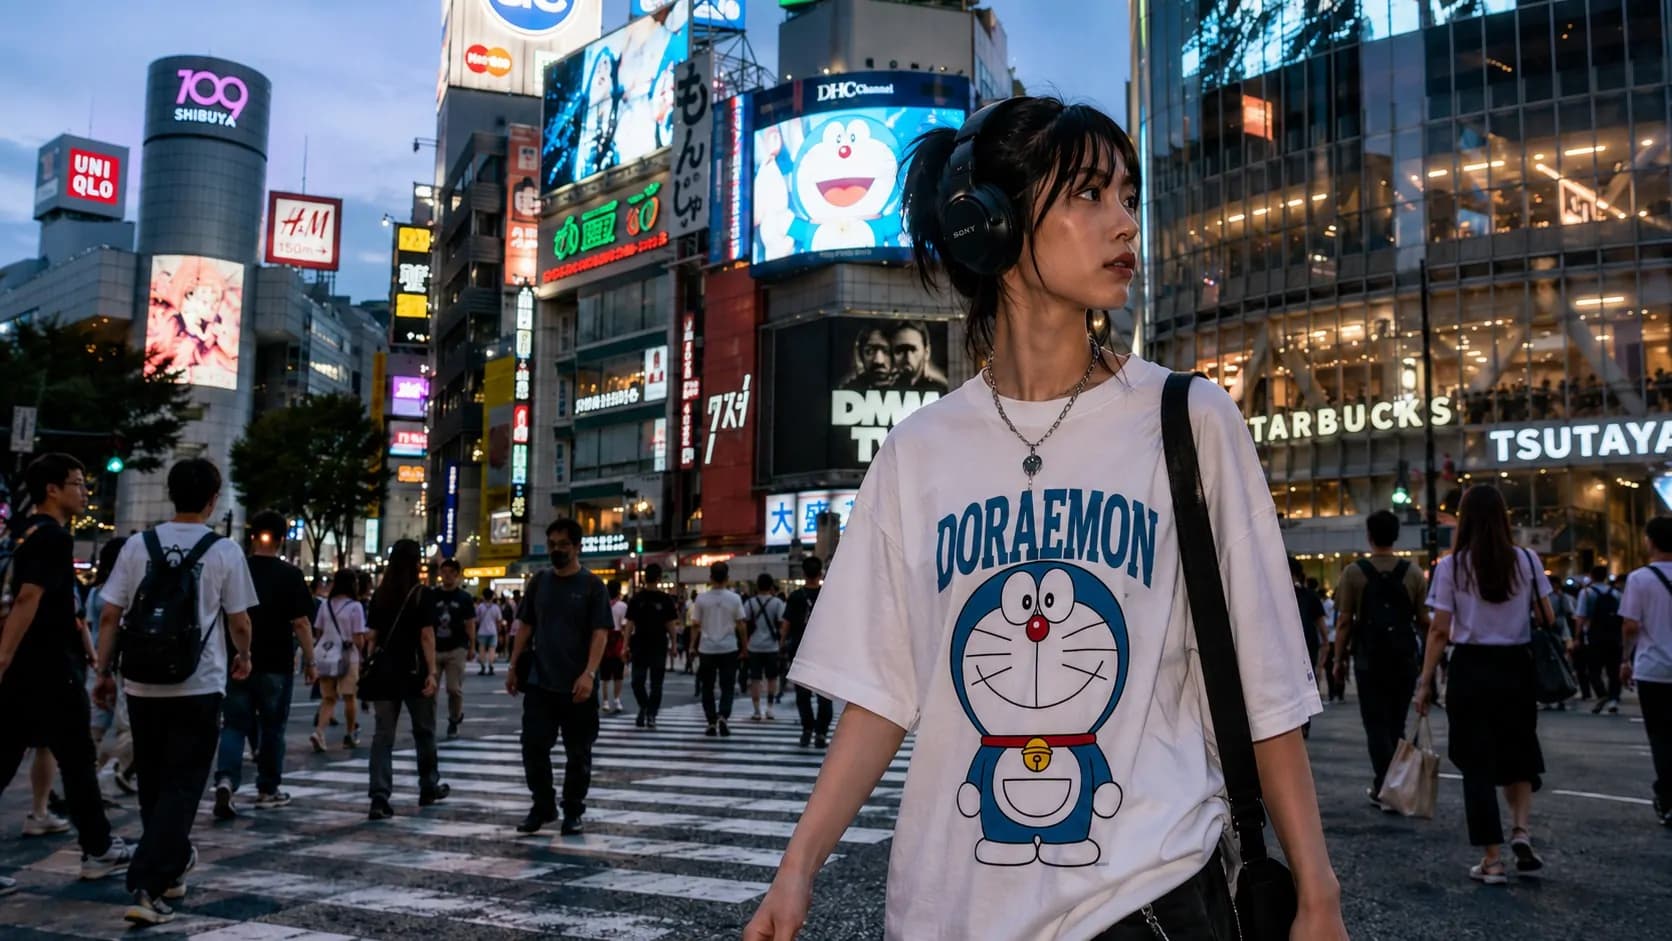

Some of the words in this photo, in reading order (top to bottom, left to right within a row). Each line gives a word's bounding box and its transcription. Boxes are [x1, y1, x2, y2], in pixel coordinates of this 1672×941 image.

[176, 69, 248, 120] 109
[817, 81, 856, 101] DHC
[174, 108, 236, 128] SHIBUYA
[74, 154, 111, 179] UNI
[72, 174, 114, 199] QLO
[281, 207, 330, 239] H&M
[953, 225, 975, 238] SONY
[280, 242, 314, 256] 150m
[1245, 397, 1452, 443] TARBUCKS
[851, 427, 888, 463] T
[937, 488, 1159, 593] DORAEMON
